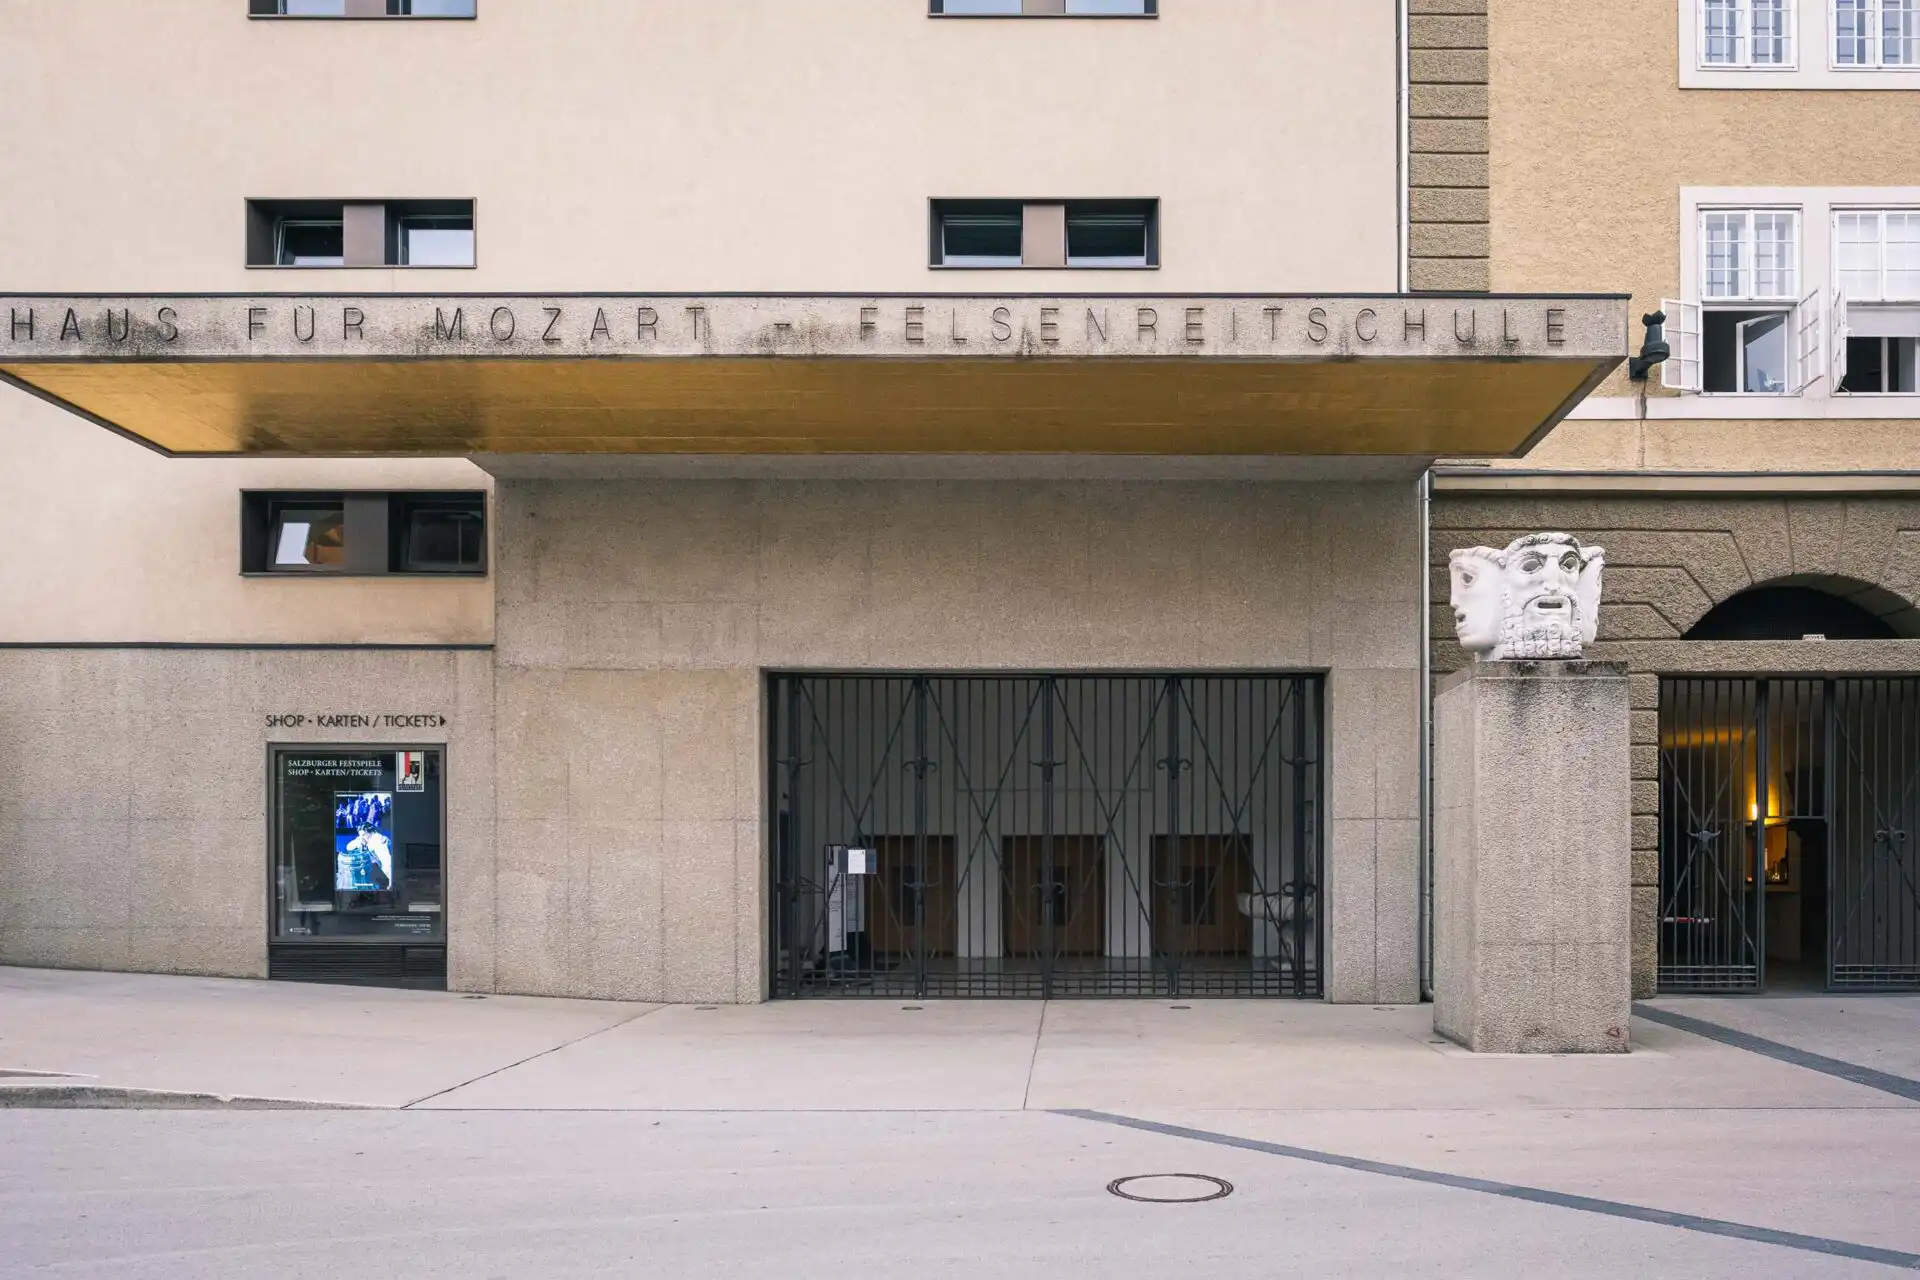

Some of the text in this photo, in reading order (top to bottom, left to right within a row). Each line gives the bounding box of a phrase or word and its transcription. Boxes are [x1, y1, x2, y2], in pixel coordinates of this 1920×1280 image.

[10, 306, 179, 342] HAUS
[247, 305, 366, 343] FÜR
[434, 306, 705, 342] MOZART
[859, 306, 1567, 343] FELSENREITSCHULE
[265, 715, 304, 728] SHOP
[317, 715, 369, 728] KARTEN
[383, 715, 437, 728] TICKETS
[287, 759, 382, 767] SALZBURGER FESTSPIELE
[287, 768, 309, 776] SHOP
